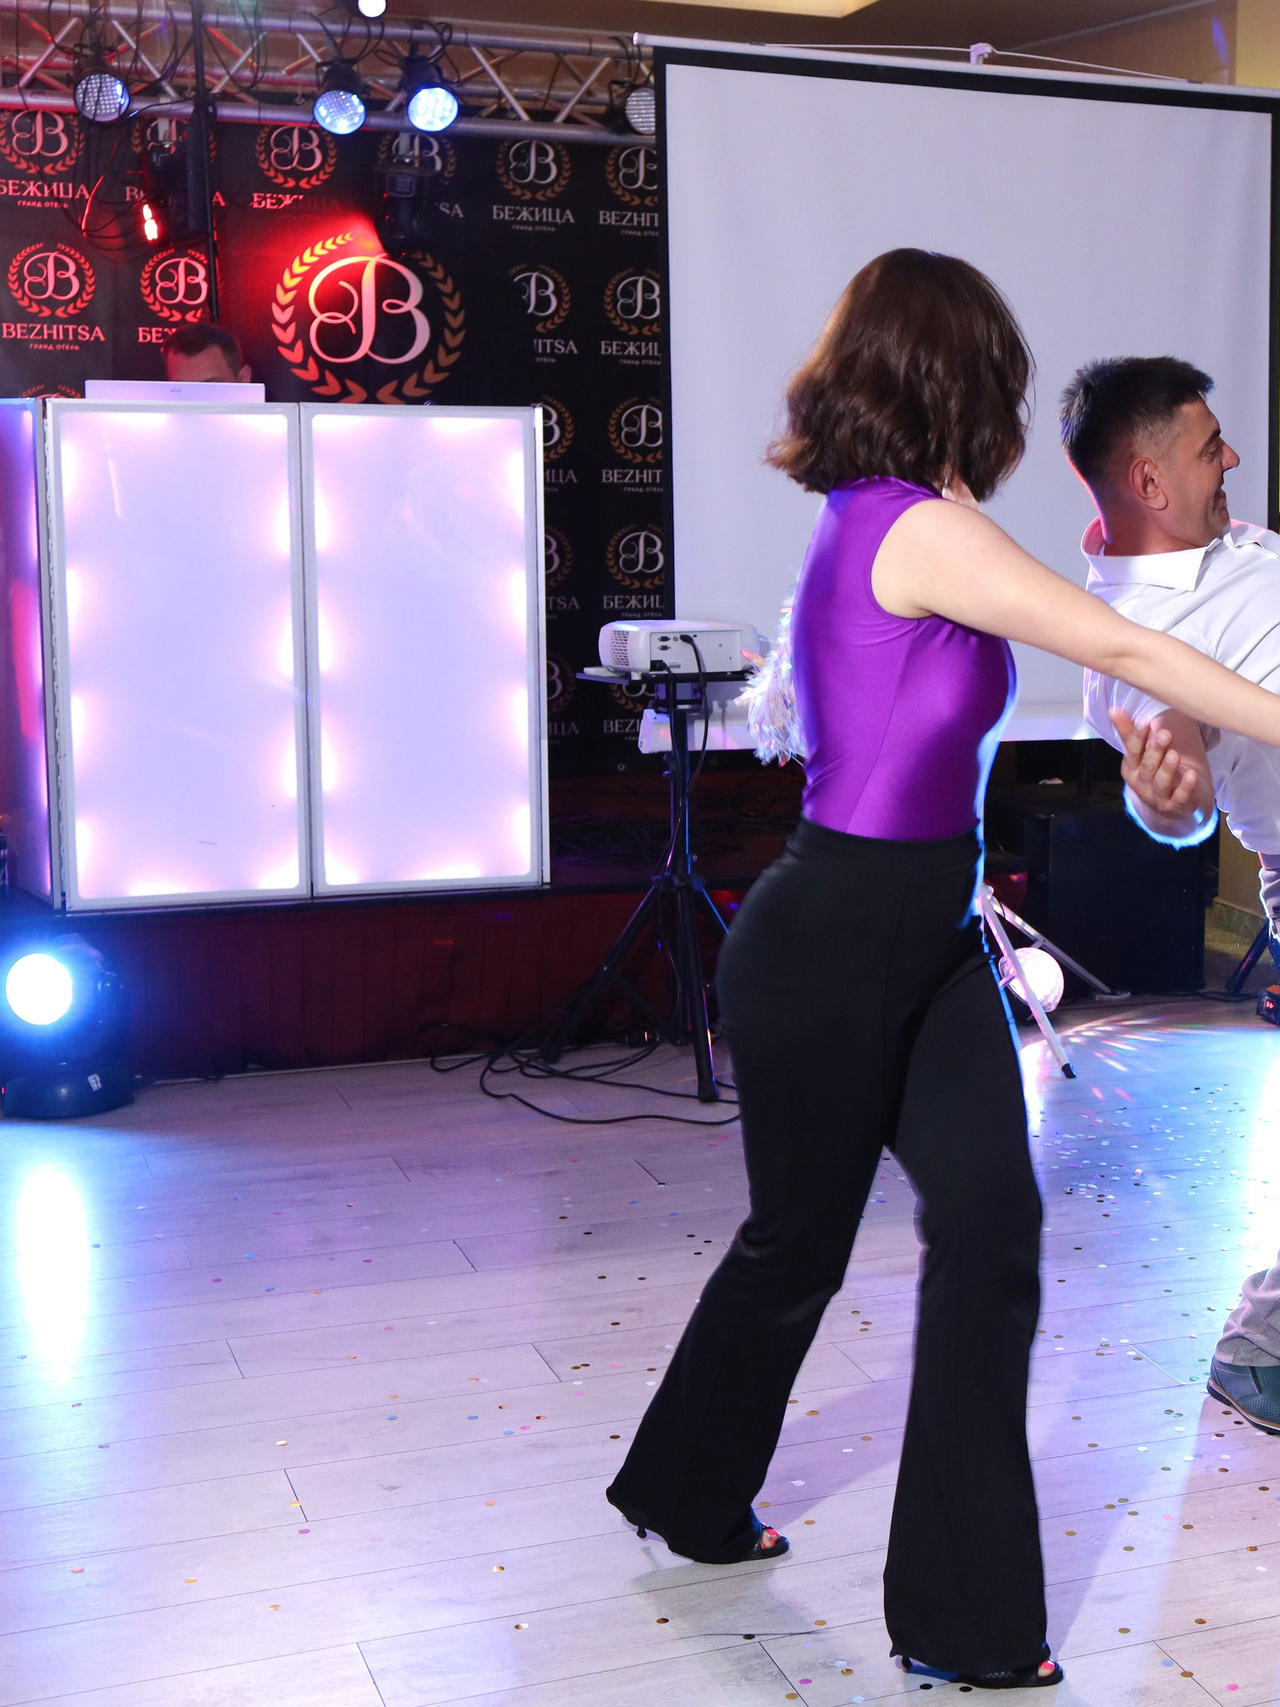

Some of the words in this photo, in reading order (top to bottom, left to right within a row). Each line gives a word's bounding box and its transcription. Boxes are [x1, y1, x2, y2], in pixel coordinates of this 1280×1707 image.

[44, 201, 69, 209] ОТЕЬ
[252, 192, 304, 209] БЕЖ
[492, 205, 575, 224] БЕЖИЦА
[599, 210, 659, 227] BEZHIT
[1, 323, 106, 342] BEZHITSA
[600, 340, 661, 356] БЕЖИ
[602, 469, 662, 483] BEZHIT
[603, 595, 664, 609] БЕЖИ
